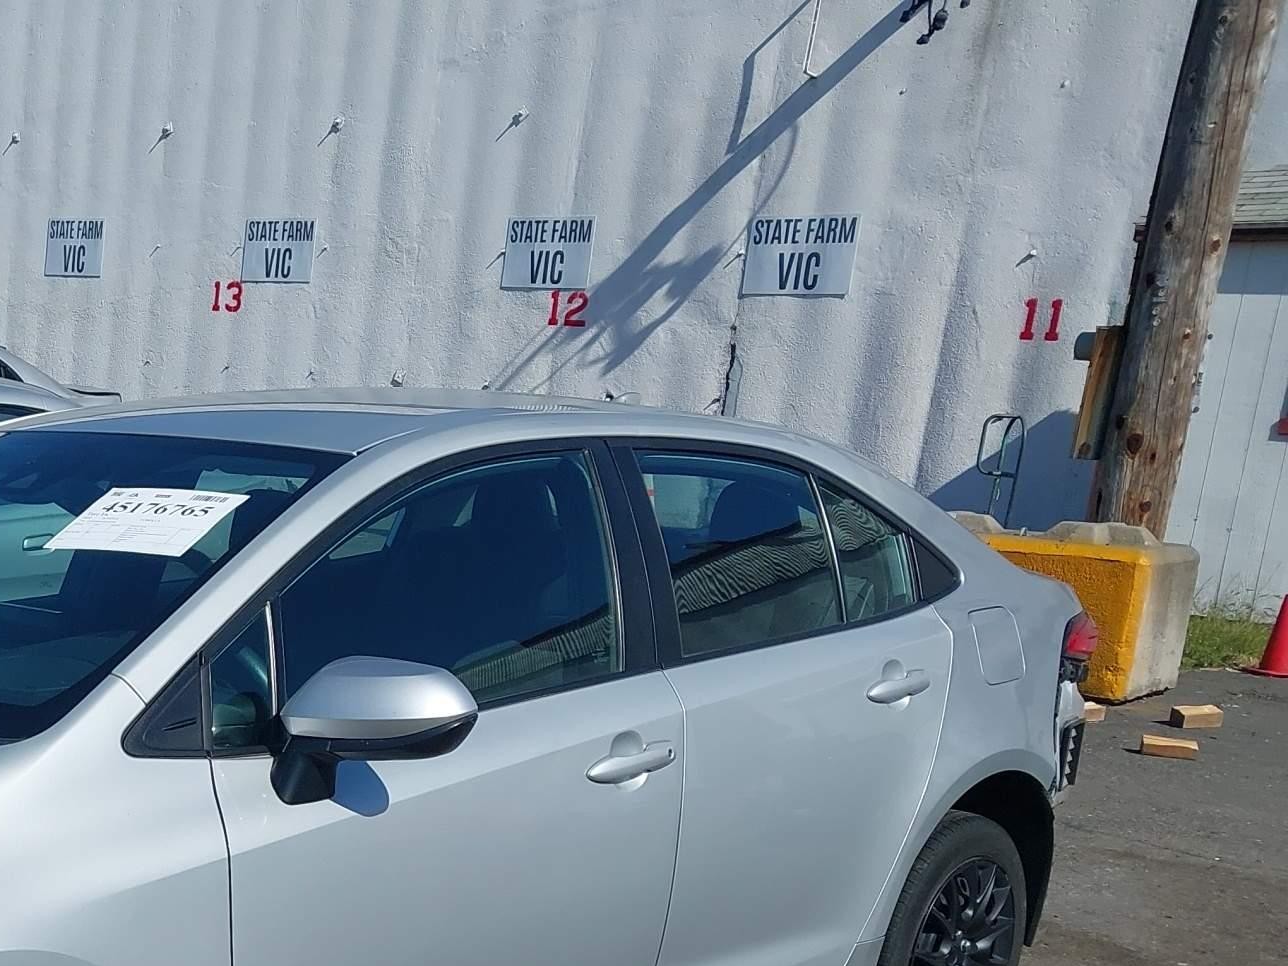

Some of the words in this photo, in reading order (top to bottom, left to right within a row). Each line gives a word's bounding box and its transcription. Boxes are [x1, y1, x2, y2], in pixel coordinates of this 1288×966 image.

[50, 220, 75, 239] STATE
[77, 220, 103, 240] FARM
[248, 221, 279, 241] STATE
[281, 221, 314, 241] FARM
[511, 220, 548, 243] STATE
[551, 219, 592, 243] FARM
[753, 219, 802, 245] STATE
[805, 217, 857, 243] FARM
[63, 244, 86, 273] VIC
[265, 247, 292, 278] VIC
[530, 250, 565, 284] VIC
[778, 252, 821, 290] VIC
[212, 281, 243, 312] 13
[548, 289, 589, 327] 12
[1019, 298, 1063, 341] 11
[102, 502, 215, 518] 45176765
